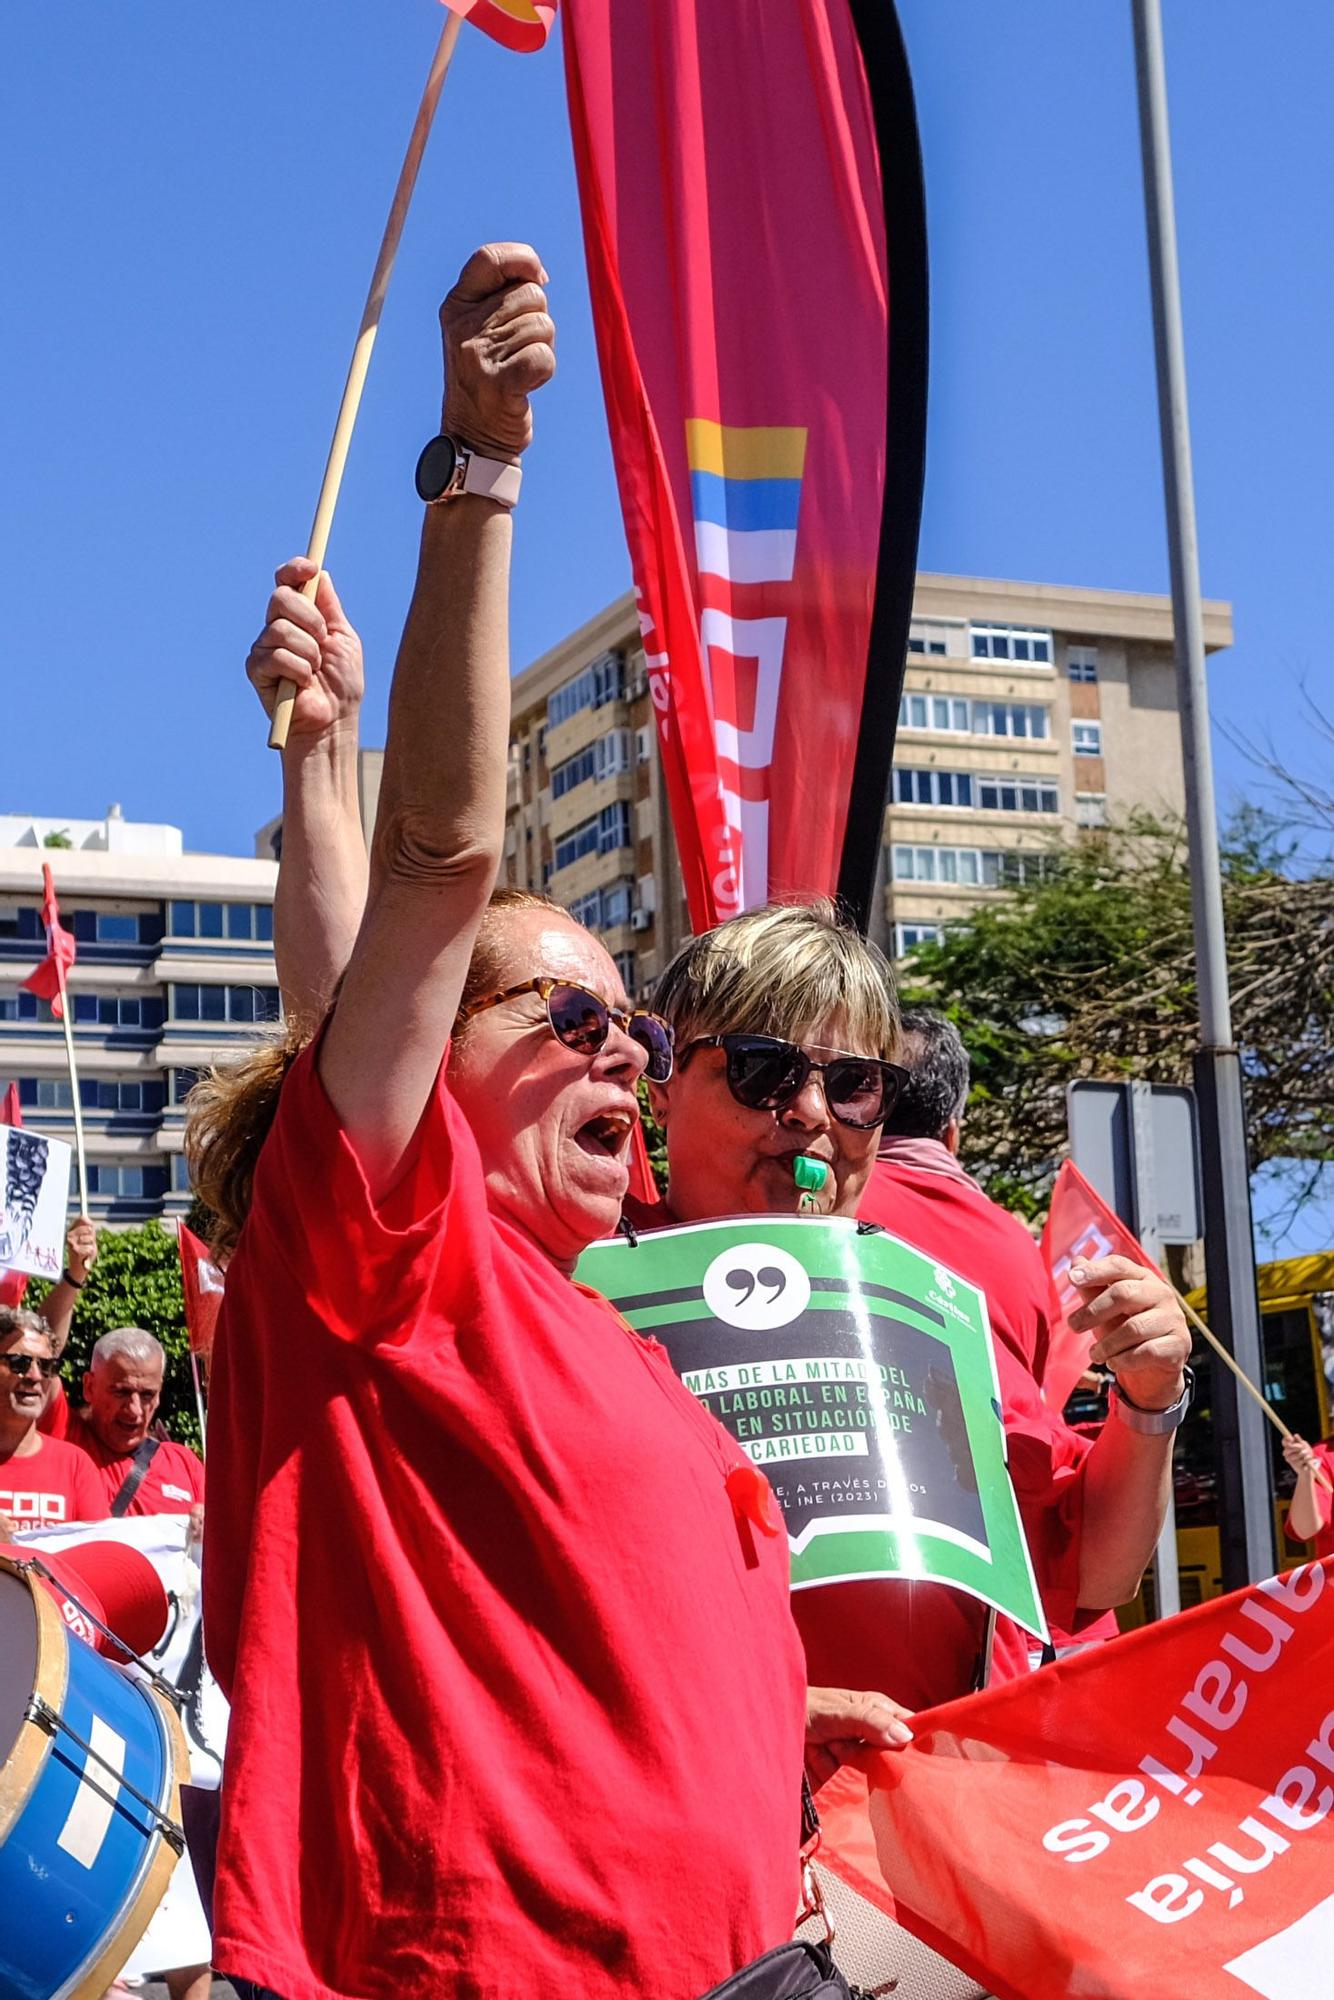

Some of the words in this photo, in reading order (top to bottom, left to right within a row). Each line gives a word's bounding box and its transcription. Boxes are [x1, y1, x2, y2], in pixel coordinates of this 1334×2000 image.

[686, 1369, 728, 1393] MÁS
[738, 1366, 763, 1386] DE
[772, 1363, 797, 1382] LA
[805, 1361, 868, 1380] MITAD
[880, 1364, 911, 1388] DEL
[720, 1385, 814, 1414] LABORAL
[821, 1385, 848, 1403] EN
[855, 1385, 927, 1416] EPAÑA
[736, 1415, 763, 1437] EN
[889, 1412, 913, 1433] DE
[742, 1434, 855, 1461] CARIEDAD
[796, 1483, 806, 1493] A
[811, 1478, 870, 1492] TRAVÉS
[797, 1494, 824, 1507] INE
[831, 1491, 878, 1504] (2023)
[1042, 1561, 1326, 1863] anarias
